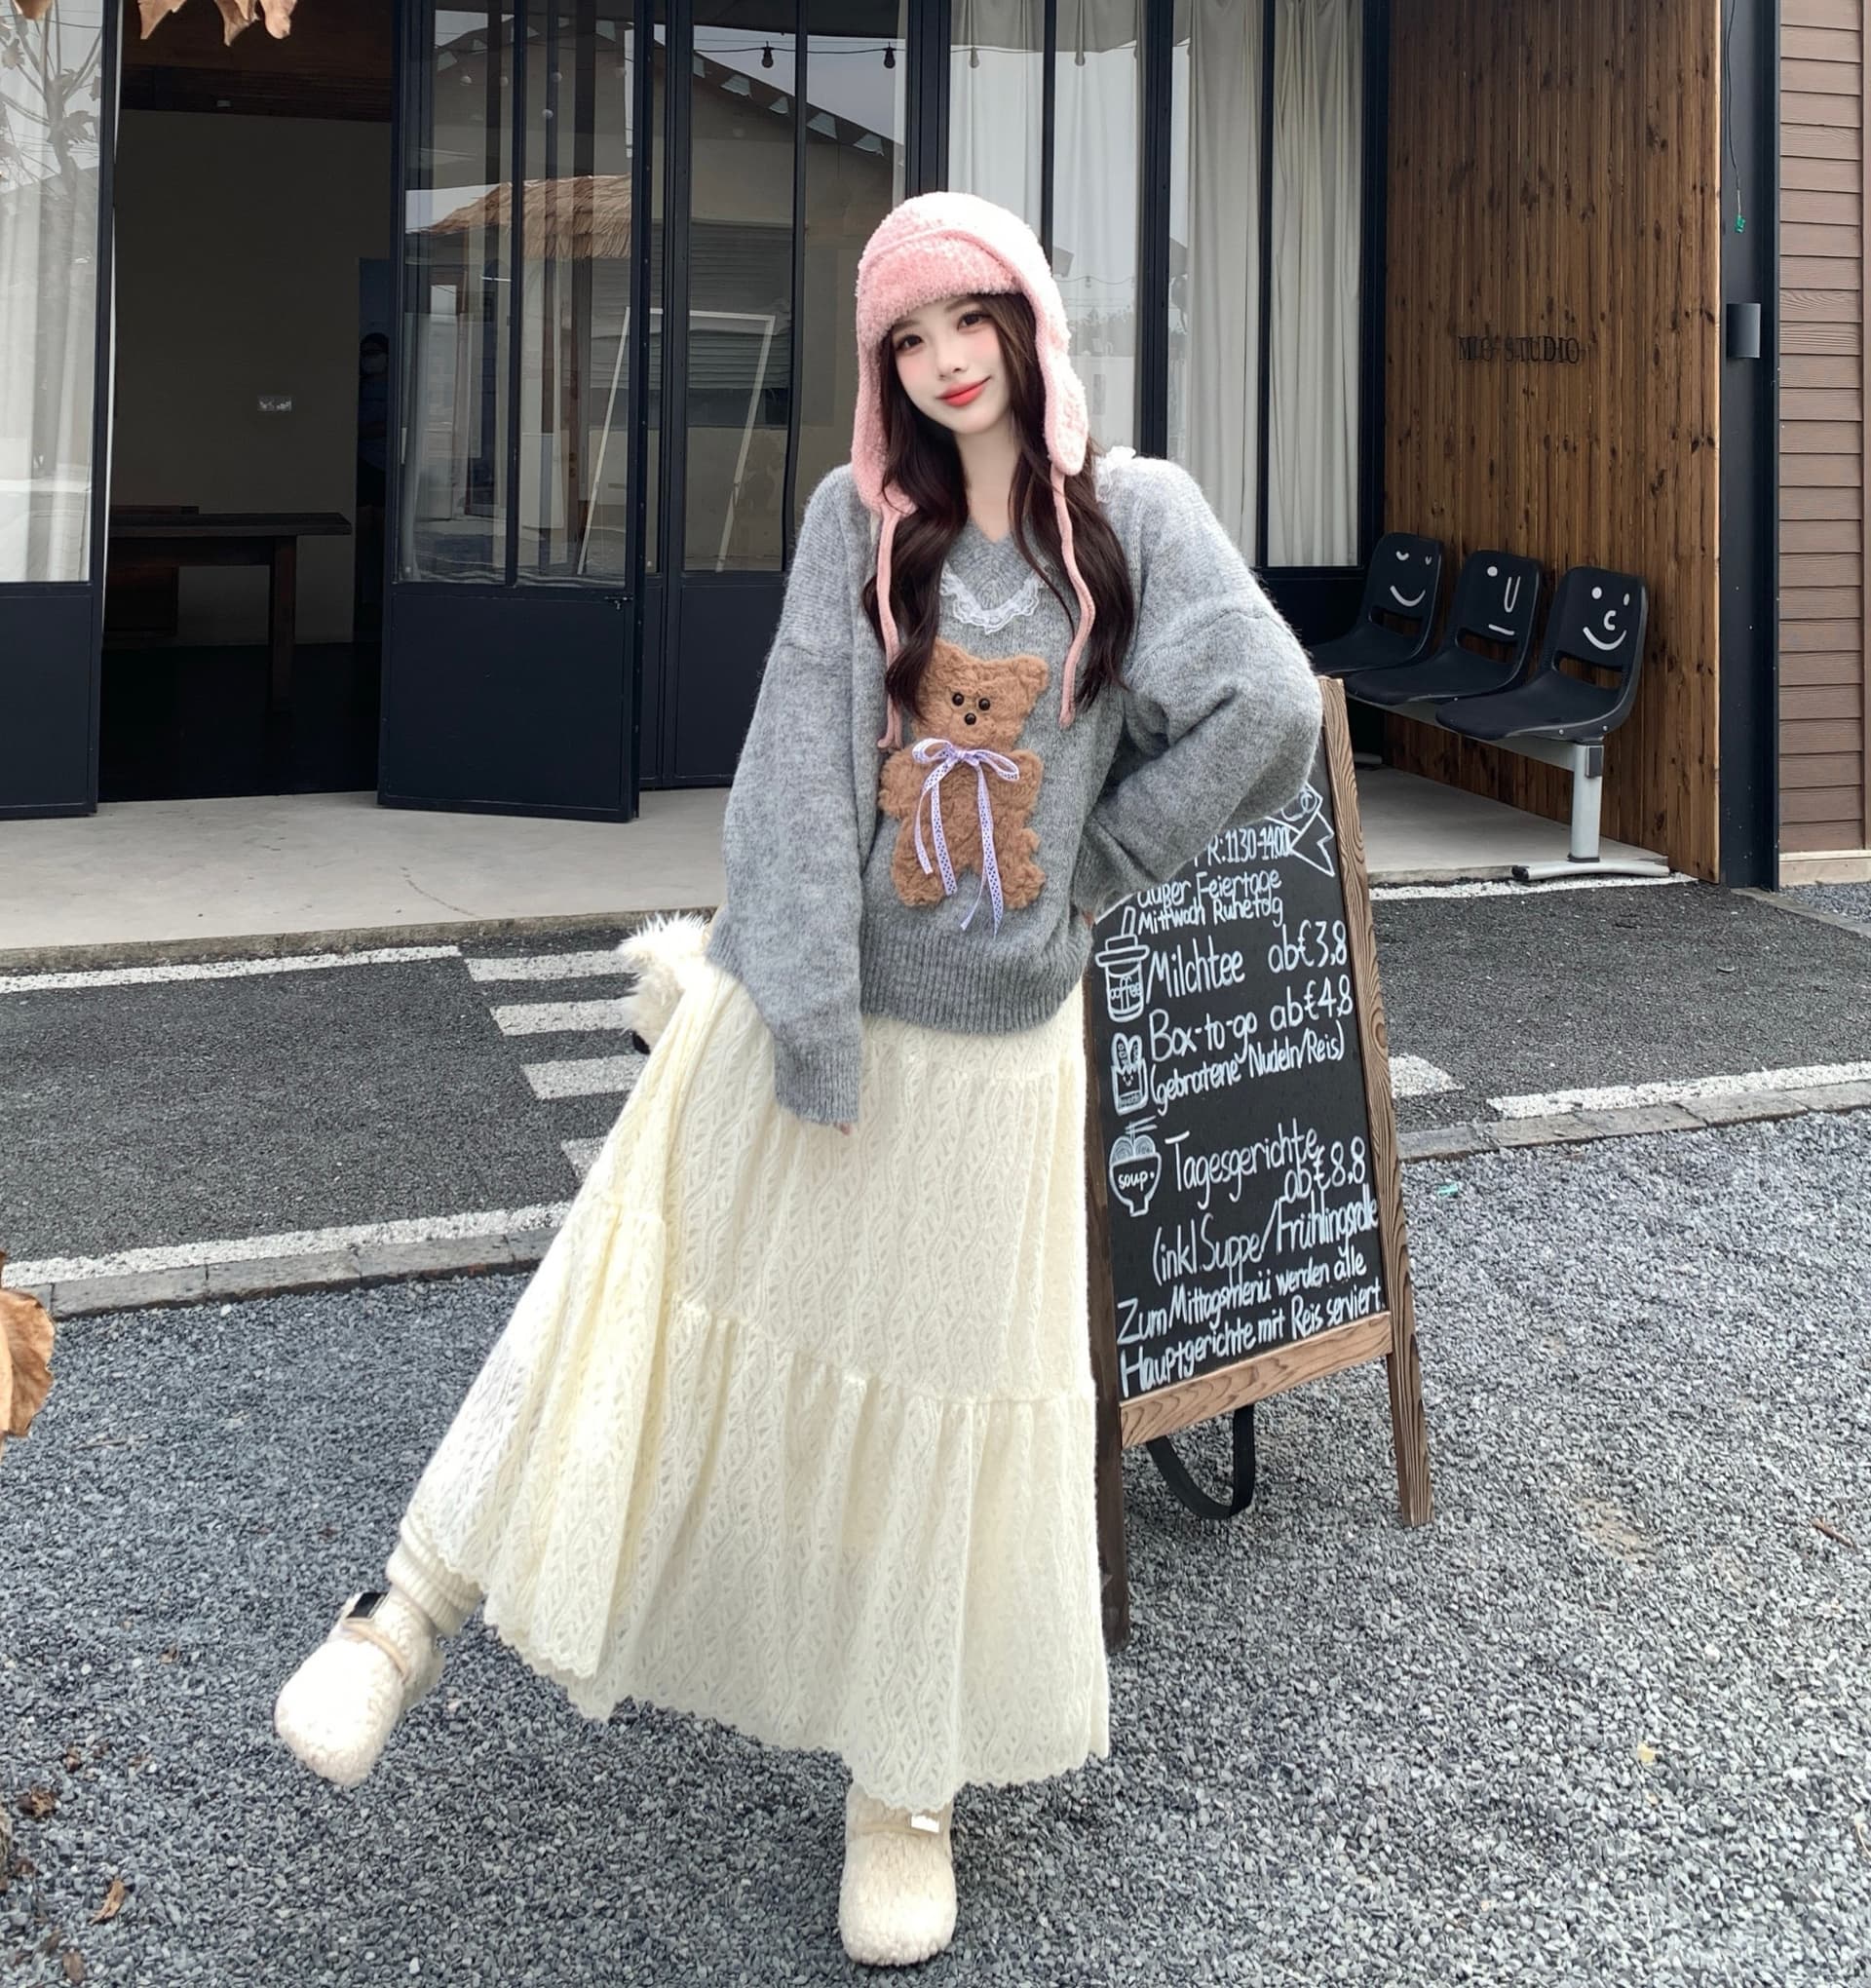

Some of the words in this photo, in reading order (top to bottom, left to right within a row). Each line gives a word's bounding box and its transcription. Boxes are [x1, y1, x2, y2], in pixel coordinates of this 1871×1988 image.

[1504, 335, 1581, 364] STUDIO
[1138, 897, 1205, 936] Mittwoch
[1145, 935, 1245, 1005] Milchtee
[1149, 1009, 1257, 1064] Box-to-go
[1165, 1118, 1318, 1210] Tagesgerichte
[1117, 1297, 1167, 1345] Zum
[1276, 1255, 1330, 1296] werden
[1121, 1318, 1256, 1398] Hauptgerichte
[1258, 1307, 1285, 1344] mit
[1291, 1294, 1324, 1340] Reis
